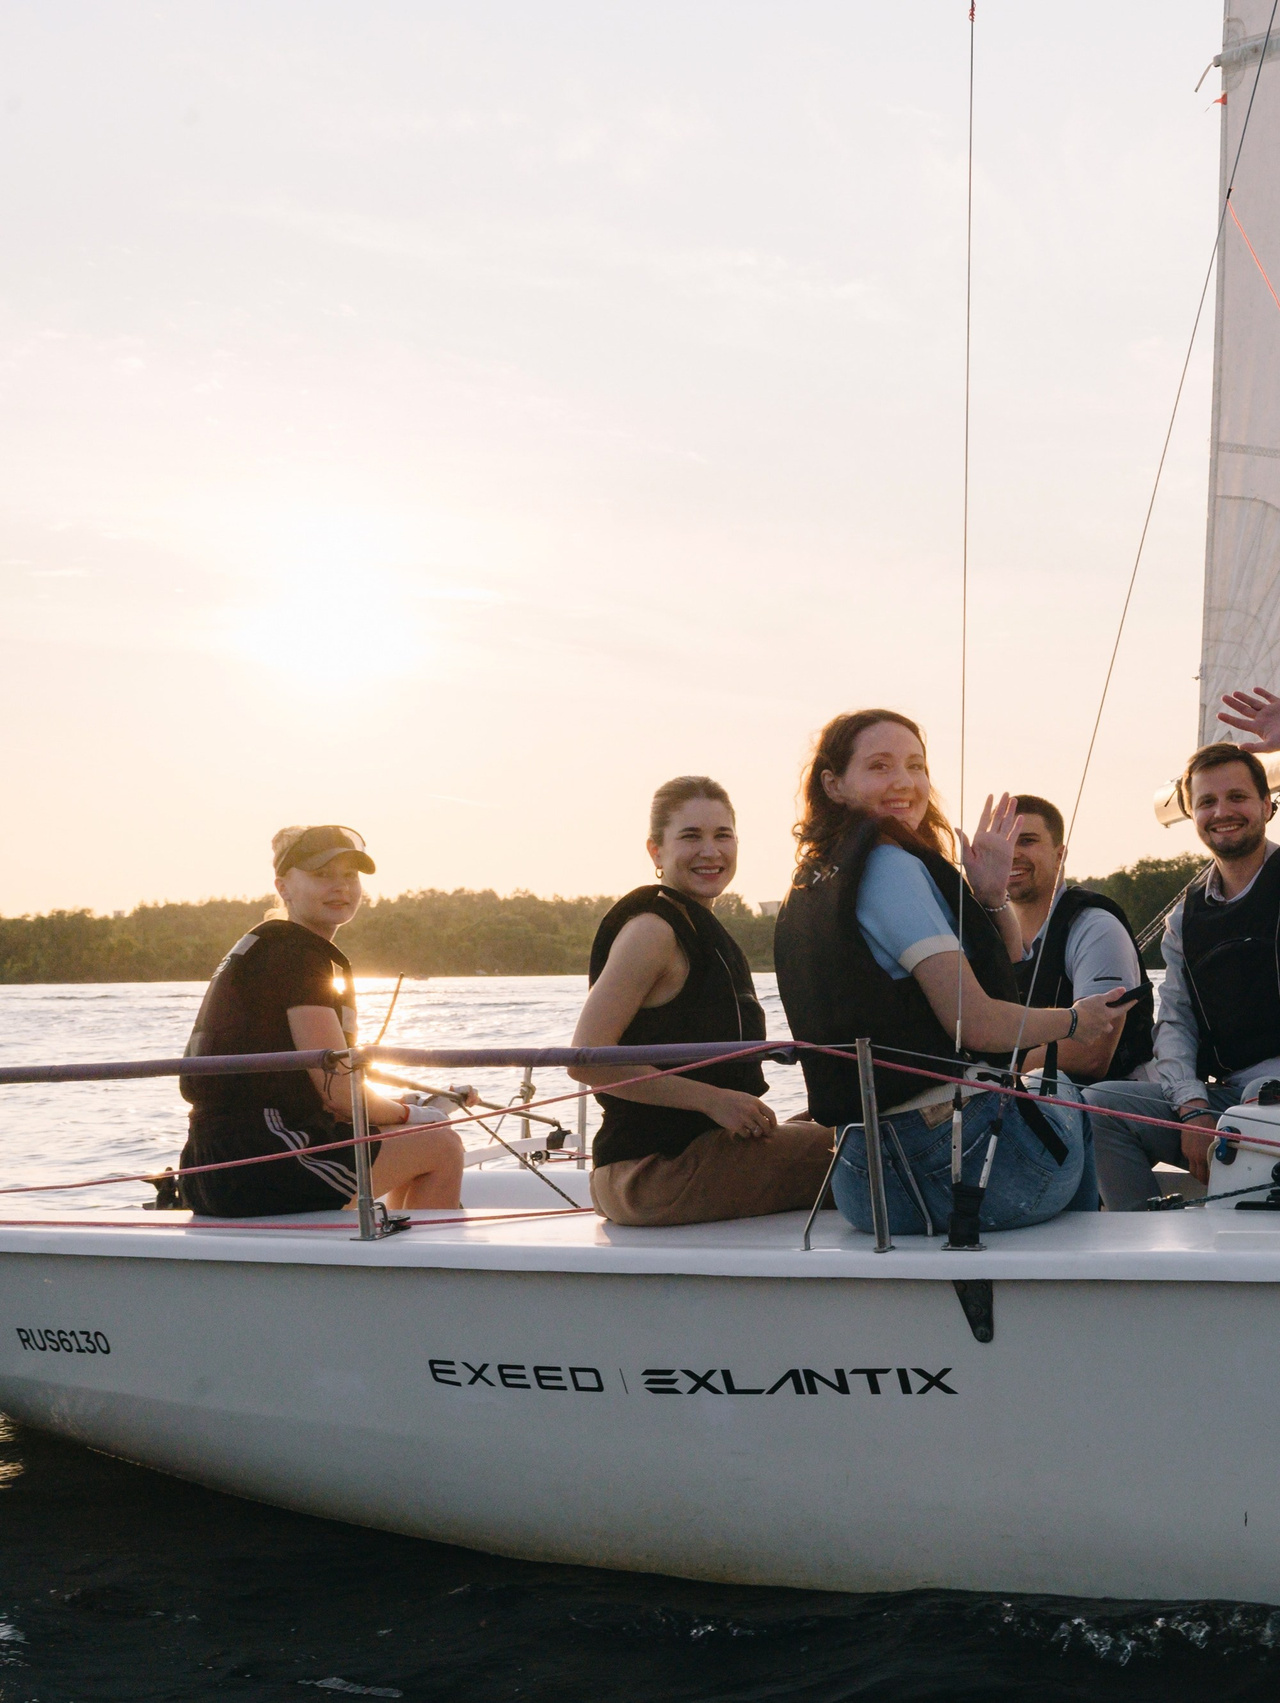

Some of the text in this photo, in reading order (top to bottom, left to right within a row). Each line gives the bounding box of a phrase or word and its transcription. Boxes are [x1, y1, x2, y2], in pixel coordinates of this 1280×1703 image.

[16, 1328, 110, 1354] RUS6130
[429, 1360, 958, 1394] EXEED EXLANTIX
